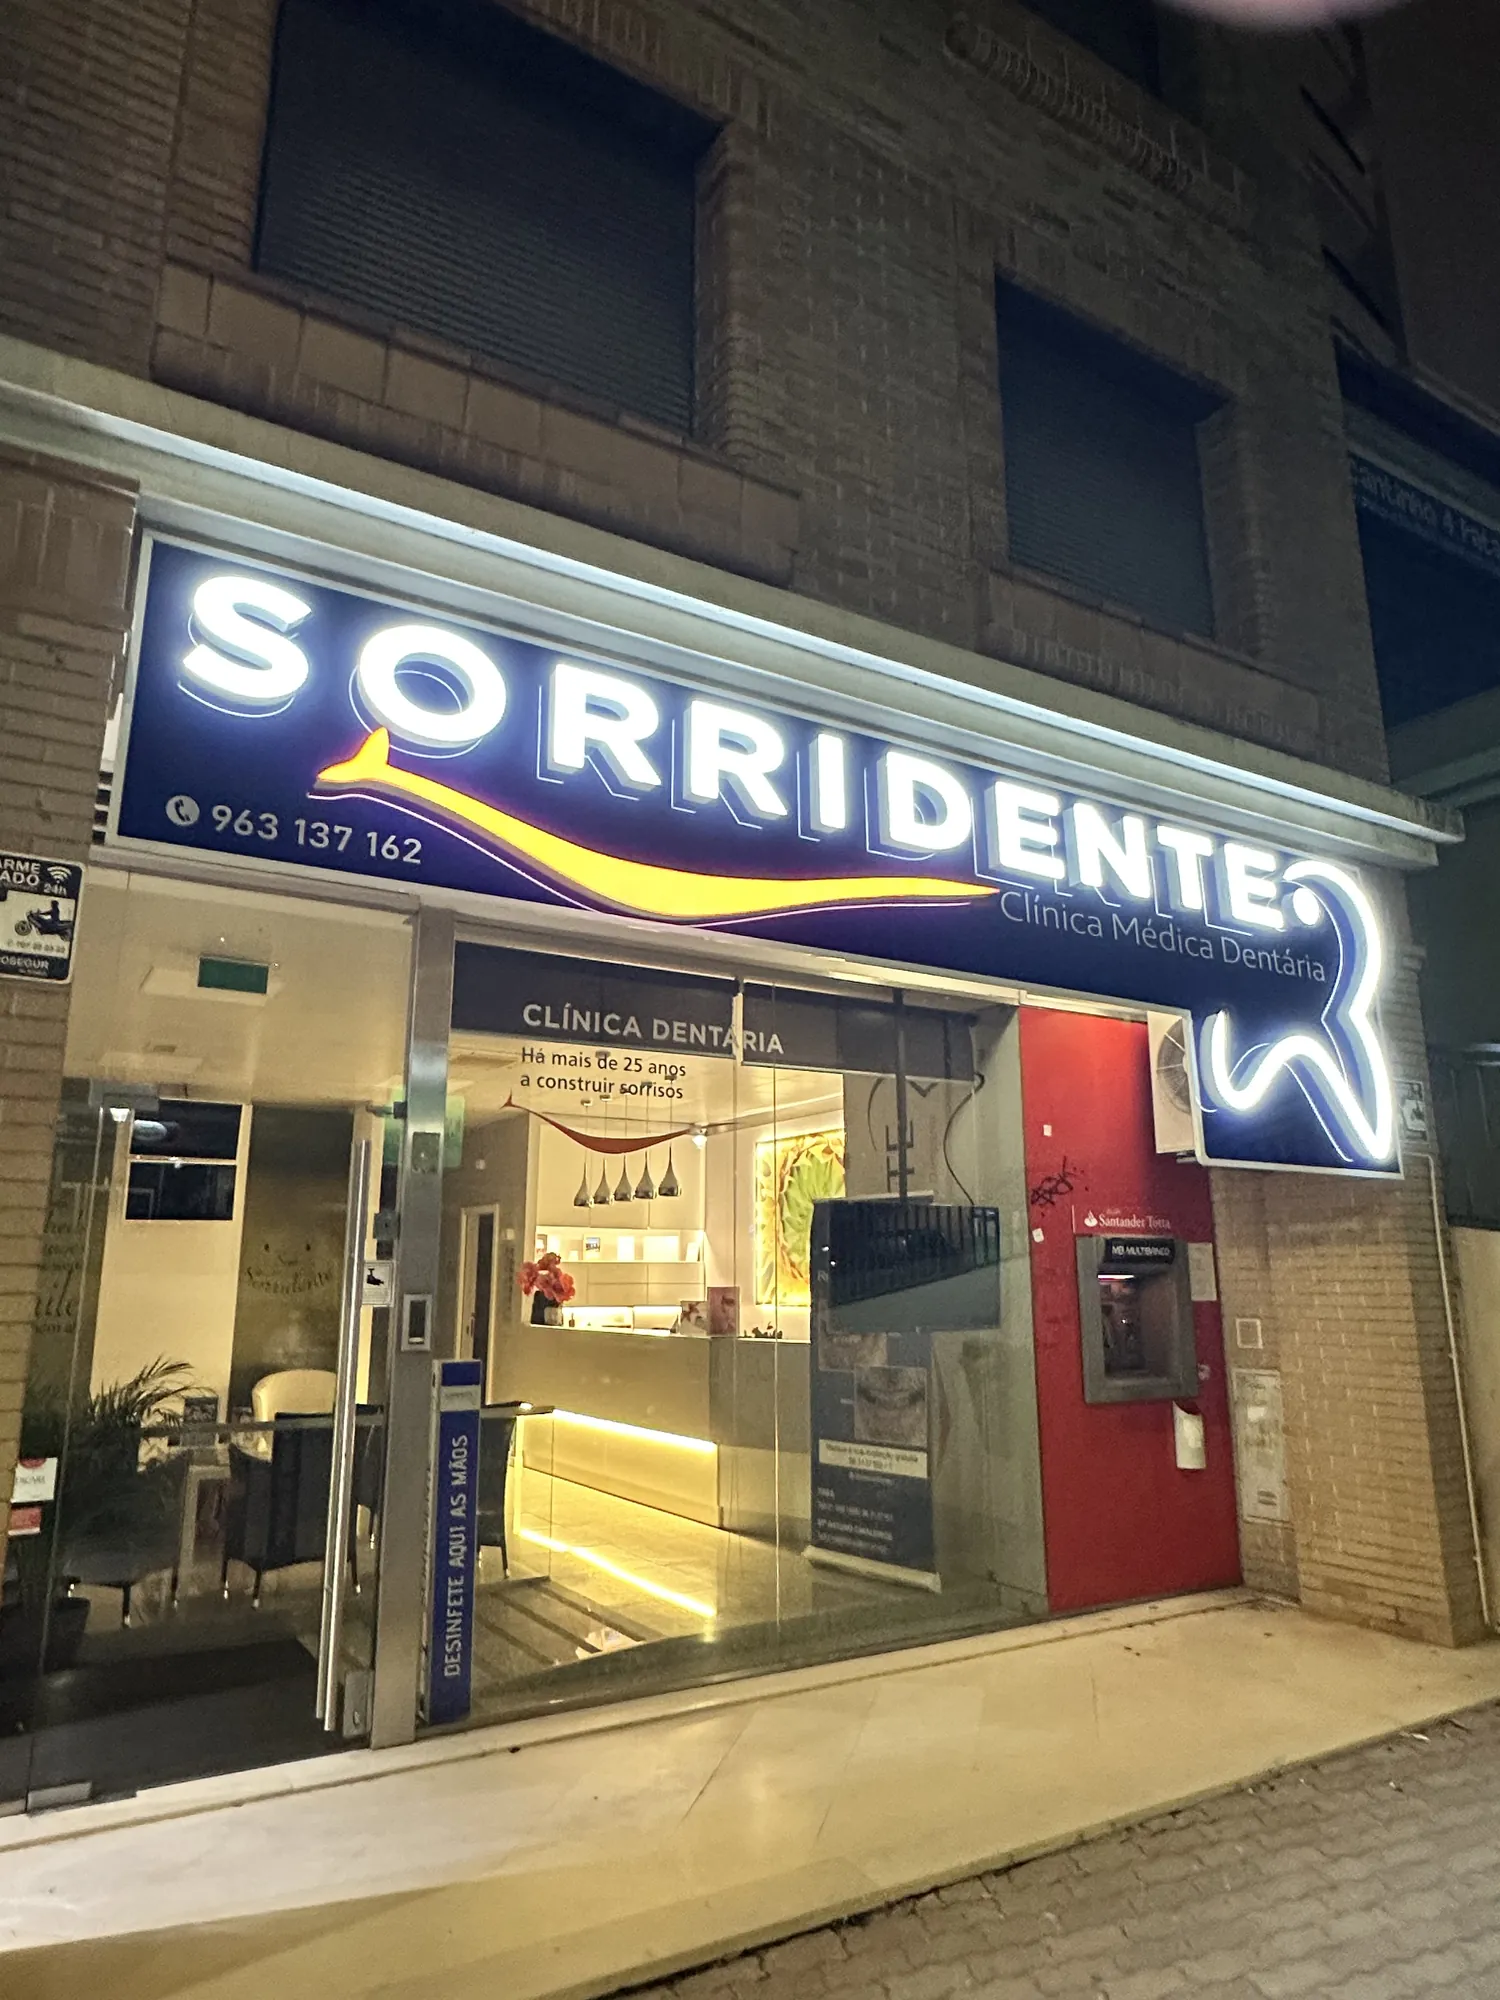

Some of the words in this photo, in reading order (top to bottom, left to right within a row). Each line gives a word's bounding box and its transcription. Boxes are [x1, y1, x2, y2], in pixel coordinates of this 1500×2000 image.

[178, 574, 1285, 934] SORRIDENTE
[211, 804, 279, 841] 963
[294, 819, 353, 852] 137
[366, 831, 423, 865] 162
[1000, 890, 1104, 938] Clínica
[1112, 912, 1215, 960] Médica
[1220, 935, 1327, 984] Dentária
[522, 1001, 643, 1040] CLÍNICA
[520, 1046, 546, 1065] Há
[550, 1050, 593, 1070] mais
[596, 1053, 619, 1073] de
[623, 1056, 643, 1073] 25
[647, 1061, 687, 1078] anos
[519, 1073, 531, 1087] a
[536, 1073, 616, 1094] construir
[618, 1081, 684, 1100] sorrisos
[1098, 1213, 1146, 1229] Santander
[450, 1434, 469, 1486] MÃOS
[450, 1496, 467, 1518] AS
[449, 1525, 467, 1570] AQUI
[444, 1576, 466, 1678] DESINFETE
